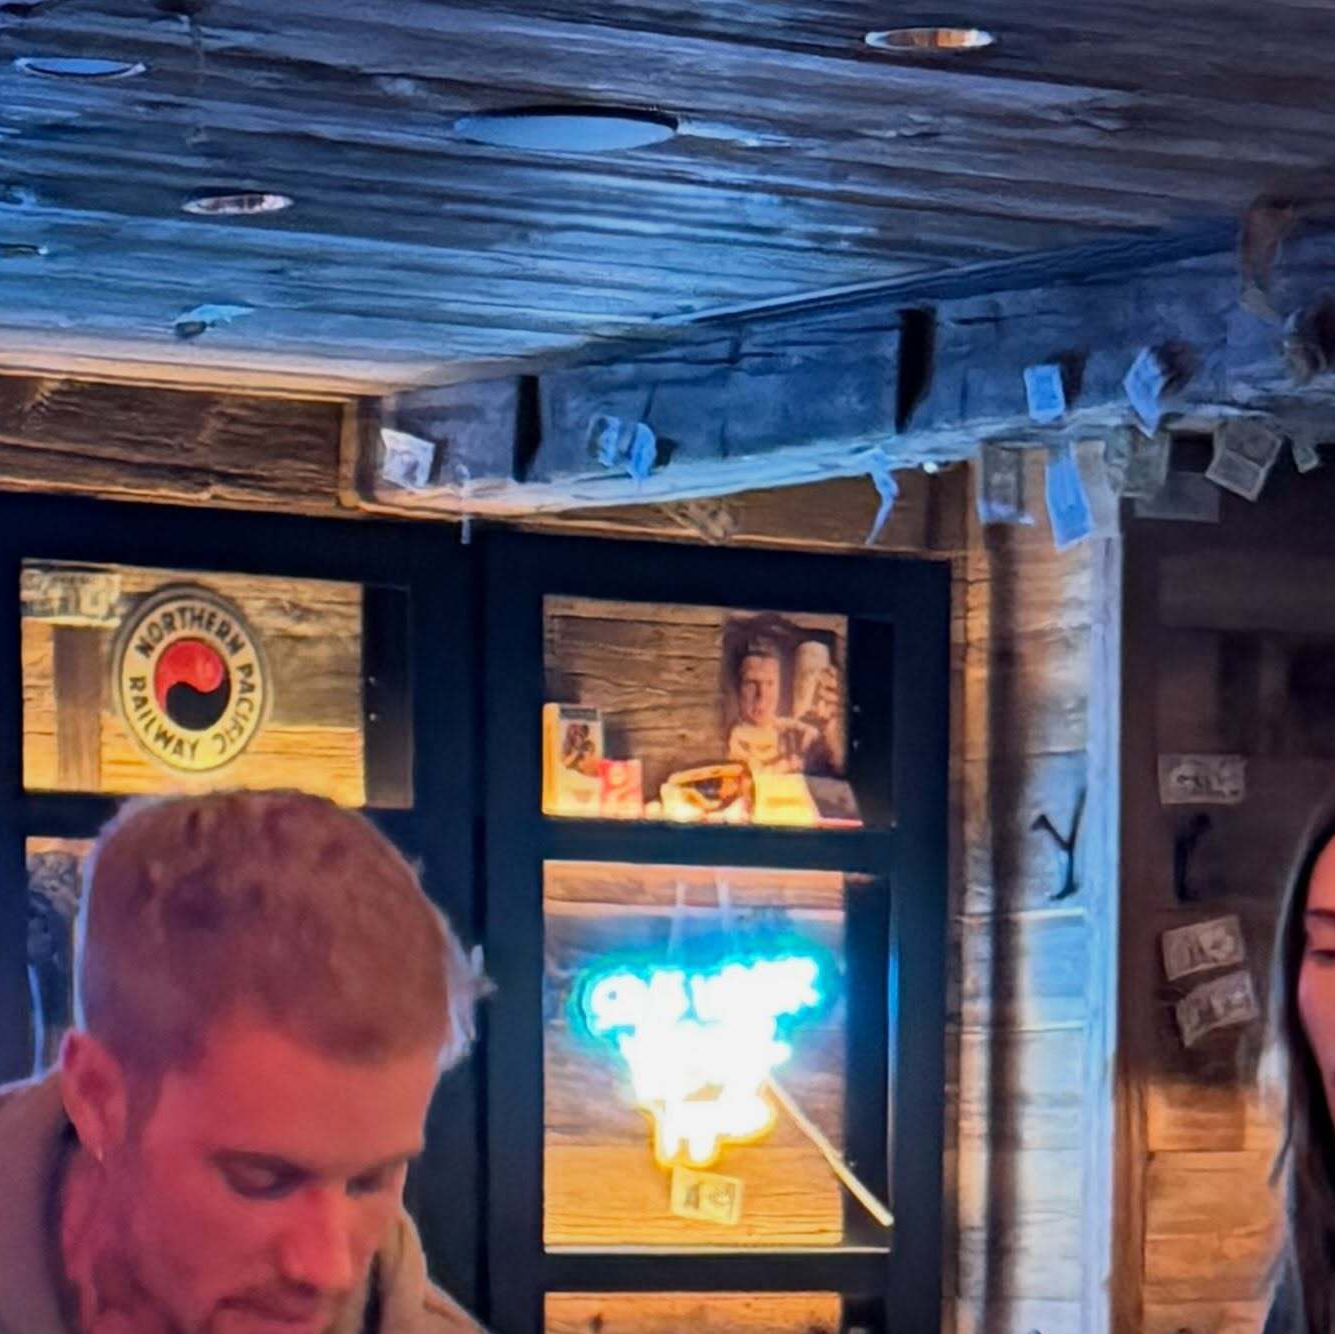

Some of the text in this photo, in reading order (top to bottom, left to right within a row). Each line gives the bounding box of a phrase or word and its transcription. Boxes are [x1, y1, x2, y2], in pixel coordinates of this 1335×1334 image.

[133, 606, 245, 659] NORTHERN
[129, 675, 200, 761] RAILWAY
[212, 662, 255, 755] PACIFIC
